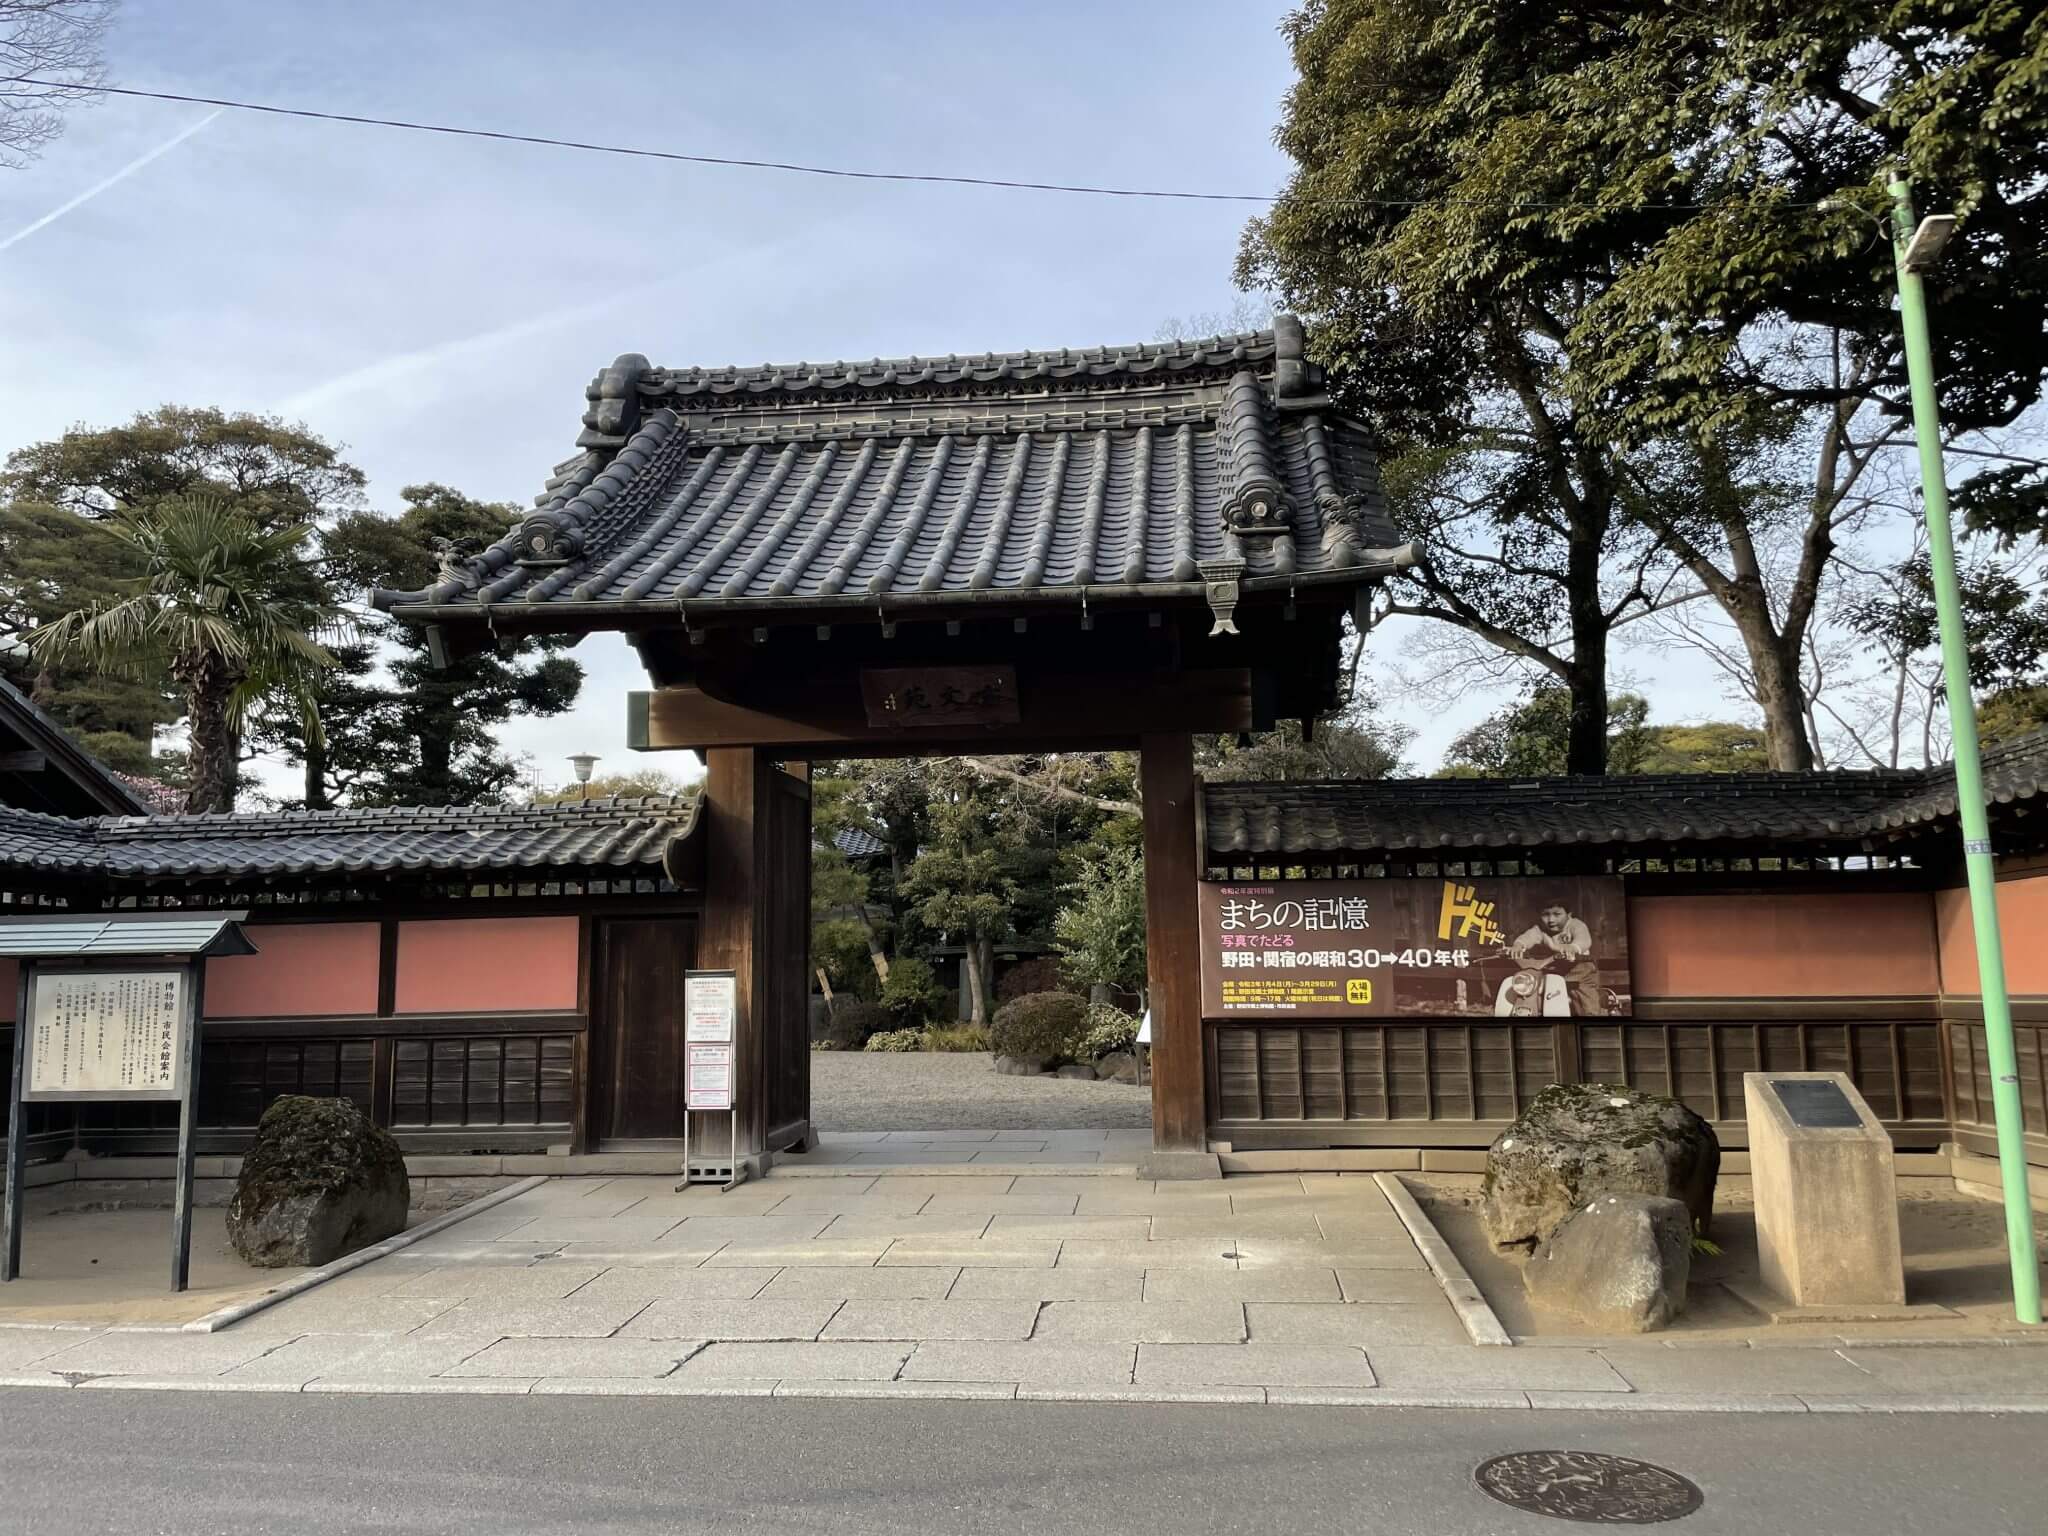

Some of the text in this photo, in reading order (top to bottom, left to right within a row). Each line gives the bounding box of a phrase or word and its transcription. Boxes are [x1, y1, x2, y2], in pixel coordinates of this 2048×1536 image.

[1220, 897, 1370, 931] まちの記憶
[1221, 934, 1295, 947] 写真でたどる
[1350, 981, 1368, 990] 入場
[1350, 991, 1368, 1001] 無料
[160, 981, 175, 1081] 博物館・市民会館案内
